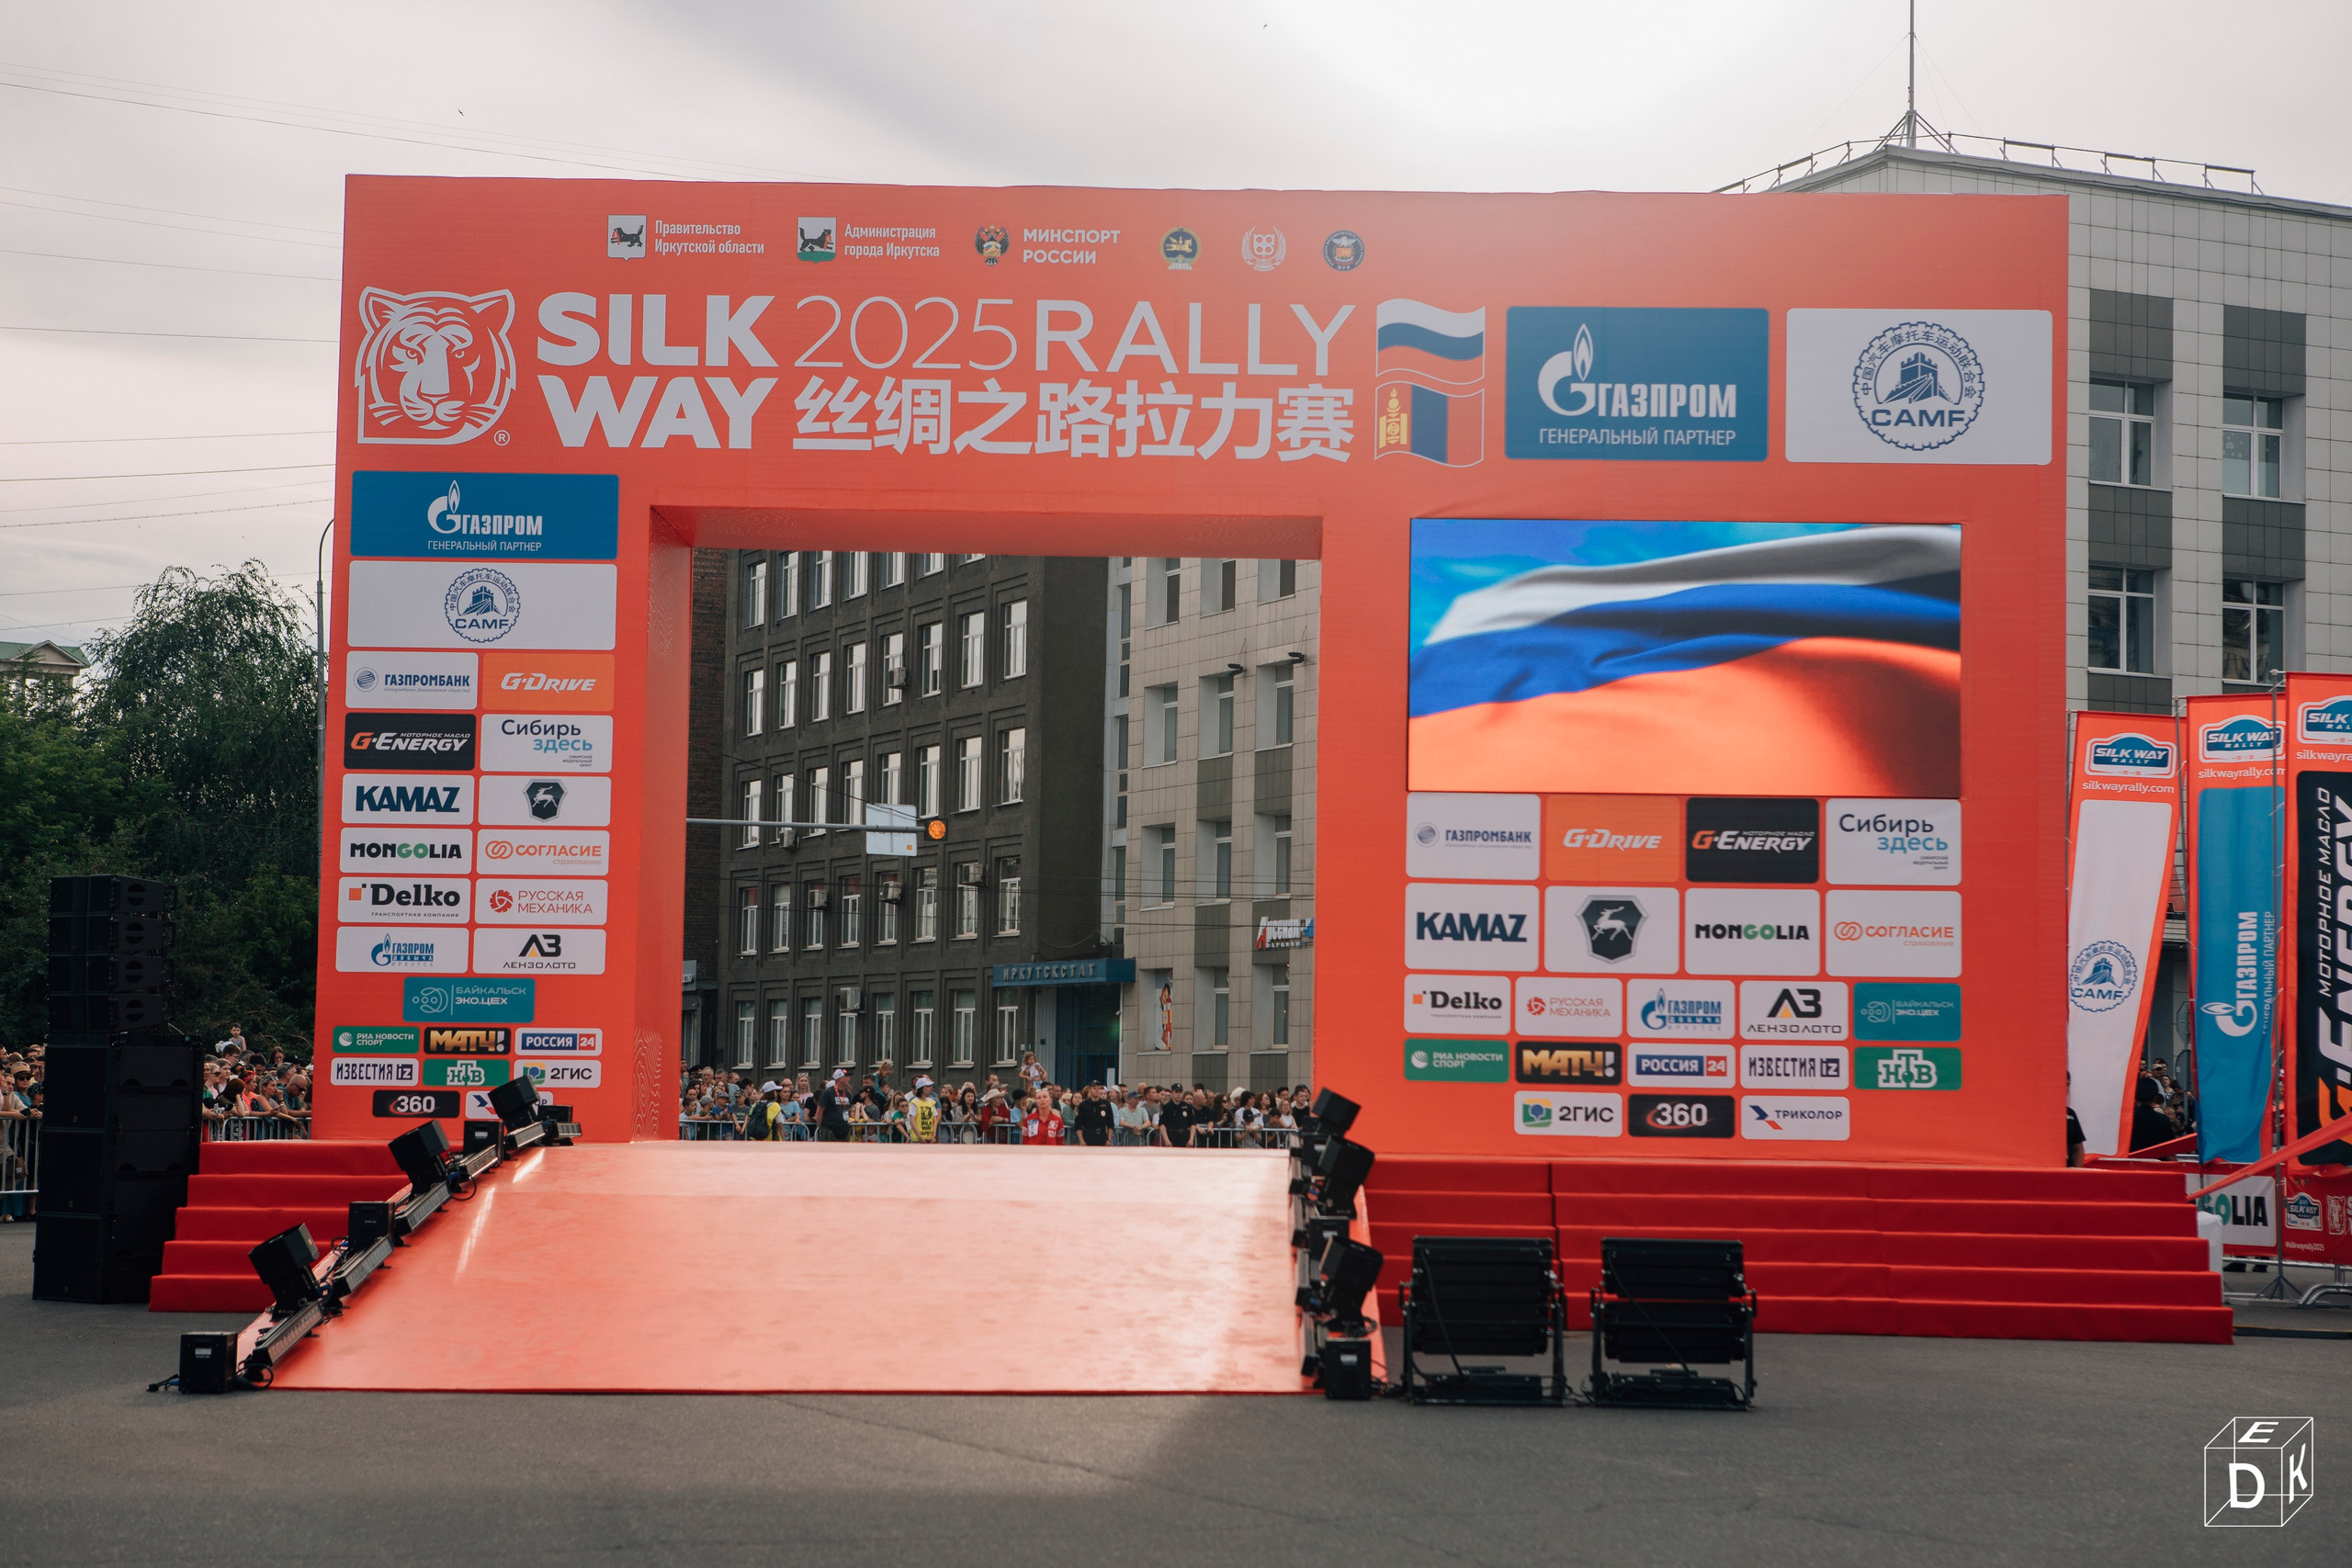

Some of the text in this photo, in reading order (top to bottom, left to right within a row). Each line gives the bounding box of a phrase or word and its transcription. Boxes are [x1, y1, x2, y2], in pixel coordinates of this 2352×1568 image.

[655, 220, 741, 235] Правительство
[844, 223, 936, 239] Администрация
[1023, 228, 1120, 244] МИНСПОРТ
[655, 239, 764, 254] Иркутской области
[844, 243, 940, 260] города Иркутска
[1023, 249, 1097, 265] РОССИИ
[537, 292, 779, 367] SILK
[794, 295, 1356, 377] 2025 RALLY
[1860, 330, 1976, 399] 中国汽车摩托车运动联合会
[1598, 382, 1737, 418] ГАЗПРОМ
[537, 375, 779, 449] WAY
[792, 375, 1355, 463] 丝绸之路拉力赛
[1871, 409, 1965, 427] CAMF
[1540, 427, 1736, 446] ГЕНЕРАЛЬНЫЙ ПАРТНЕР
[462, 514, 543, 536] ГАЗПРОМ
[427, 540, 542, 552] ГЕНЕРАЛЬНЫЙ ПАРТНЕР
[455, 618, 509, 629] CAMF
[384, 674, 470, 687] ГАЗПРОМБАНК
[2307, 713, 2348, 724] SILK
[502, 719, 582, 739] Сибирь
[2207, 732, 2245, 743] SILK
[533, 738, 593, 754] здесь
[2095, 748, 2168, 760] SILK WAY
[2082, 780, 2175, 795] silkwayrally.com
[356, 785, 460, 812] KAMAZ
[1839, 814, 1934, 837] Сибирь
[1445, 829, 1532, 843] ГАЗПРОМБАНК
[350, 842, 462, 859] MONGOLIA
[515, 845, 602, 857] СОГЛАСИЕ
[1877, 837, 1949, 853] здесь
[552, 858, 602, 866] страхование
[370, 883, 460, 907] Delko
[518, 890, 583, 902] РУССКАЯ
[2318, 787, 2332, 998] МОТОРНОЕ МАСЛО
[518, 902, 594, 915] МЕХАНИКА
[1417, 912, 1527, 942] KAMAZ
[1695, 923, 1809, 941] MONGOLIA
[1866, 925, 1954, 938] СОГЛАСИЕ
[2263, 911, 2275, 957] ПАРТНЕР
[391, 942, 435, 955] ГАЗПРОМ
[2236, 911, 2258, 998] ГАЗПРОМ
[503, 961, 576, 970] ЛЕНЗОЛОТО
[1002, 964, 1096, 981] ИРКУТСКСТАТ
[455, 986, 527, 996] БАЙКАЛЬСК
[2071, 988, 2124, 1000] CAMF
[455, 997, 508, 1006] ЭКО.ЦЕХ
[1430, 990, 1502, 1010] Delko
[1550, 998, 1603, 1007] РУССКАЯ
[1668, 1000, 1721, 1014] ГАЗПРОМ
[1895, 999, 1954, 1008] БАЙКАЛЬСК
[1550, 1008, 1611, 1017] МЕХАНИКА
[1668, 1016, 1721, 1024] ДОБЫЧА
[1895, 1009, 1939, 1017] ЭКО.ЦЕХ
[1747, 1024, 1841, 1033] ЛЕНЗОЛОТО
[429, 1030, 505, 1053] МАТЧ!
[526, 1036, 595, 1048] РОССИЯ 24
[1432, 1059, 1465, 1067] СПОРТ
[1455, 1053, 1503, 1061] НОВОСТИ
[1522, 1049, 1615, 1077] МАТЧ!
[1641, 1058, 1725, 1072] РОССИЯ 24
[336, 1063, 393, 1081] ИЗВЕСТИЯ
[447, 1060, 486, 1086] НТВ
[550, 1067, 593, 1080] 2ГИС
[1748, 1057, 1815, 1077] ИЗВЕСТИЯ
[1878, 1049, 1938, 1088] НТВ
[396, 1095, 435, 1113] 360
[1559, 1106, 1614, 1122] 2ГИС
[1656, 1102, 1708, 1126] 360
[1775, 1110, 1842, 1120] ТРИКОЛОР
